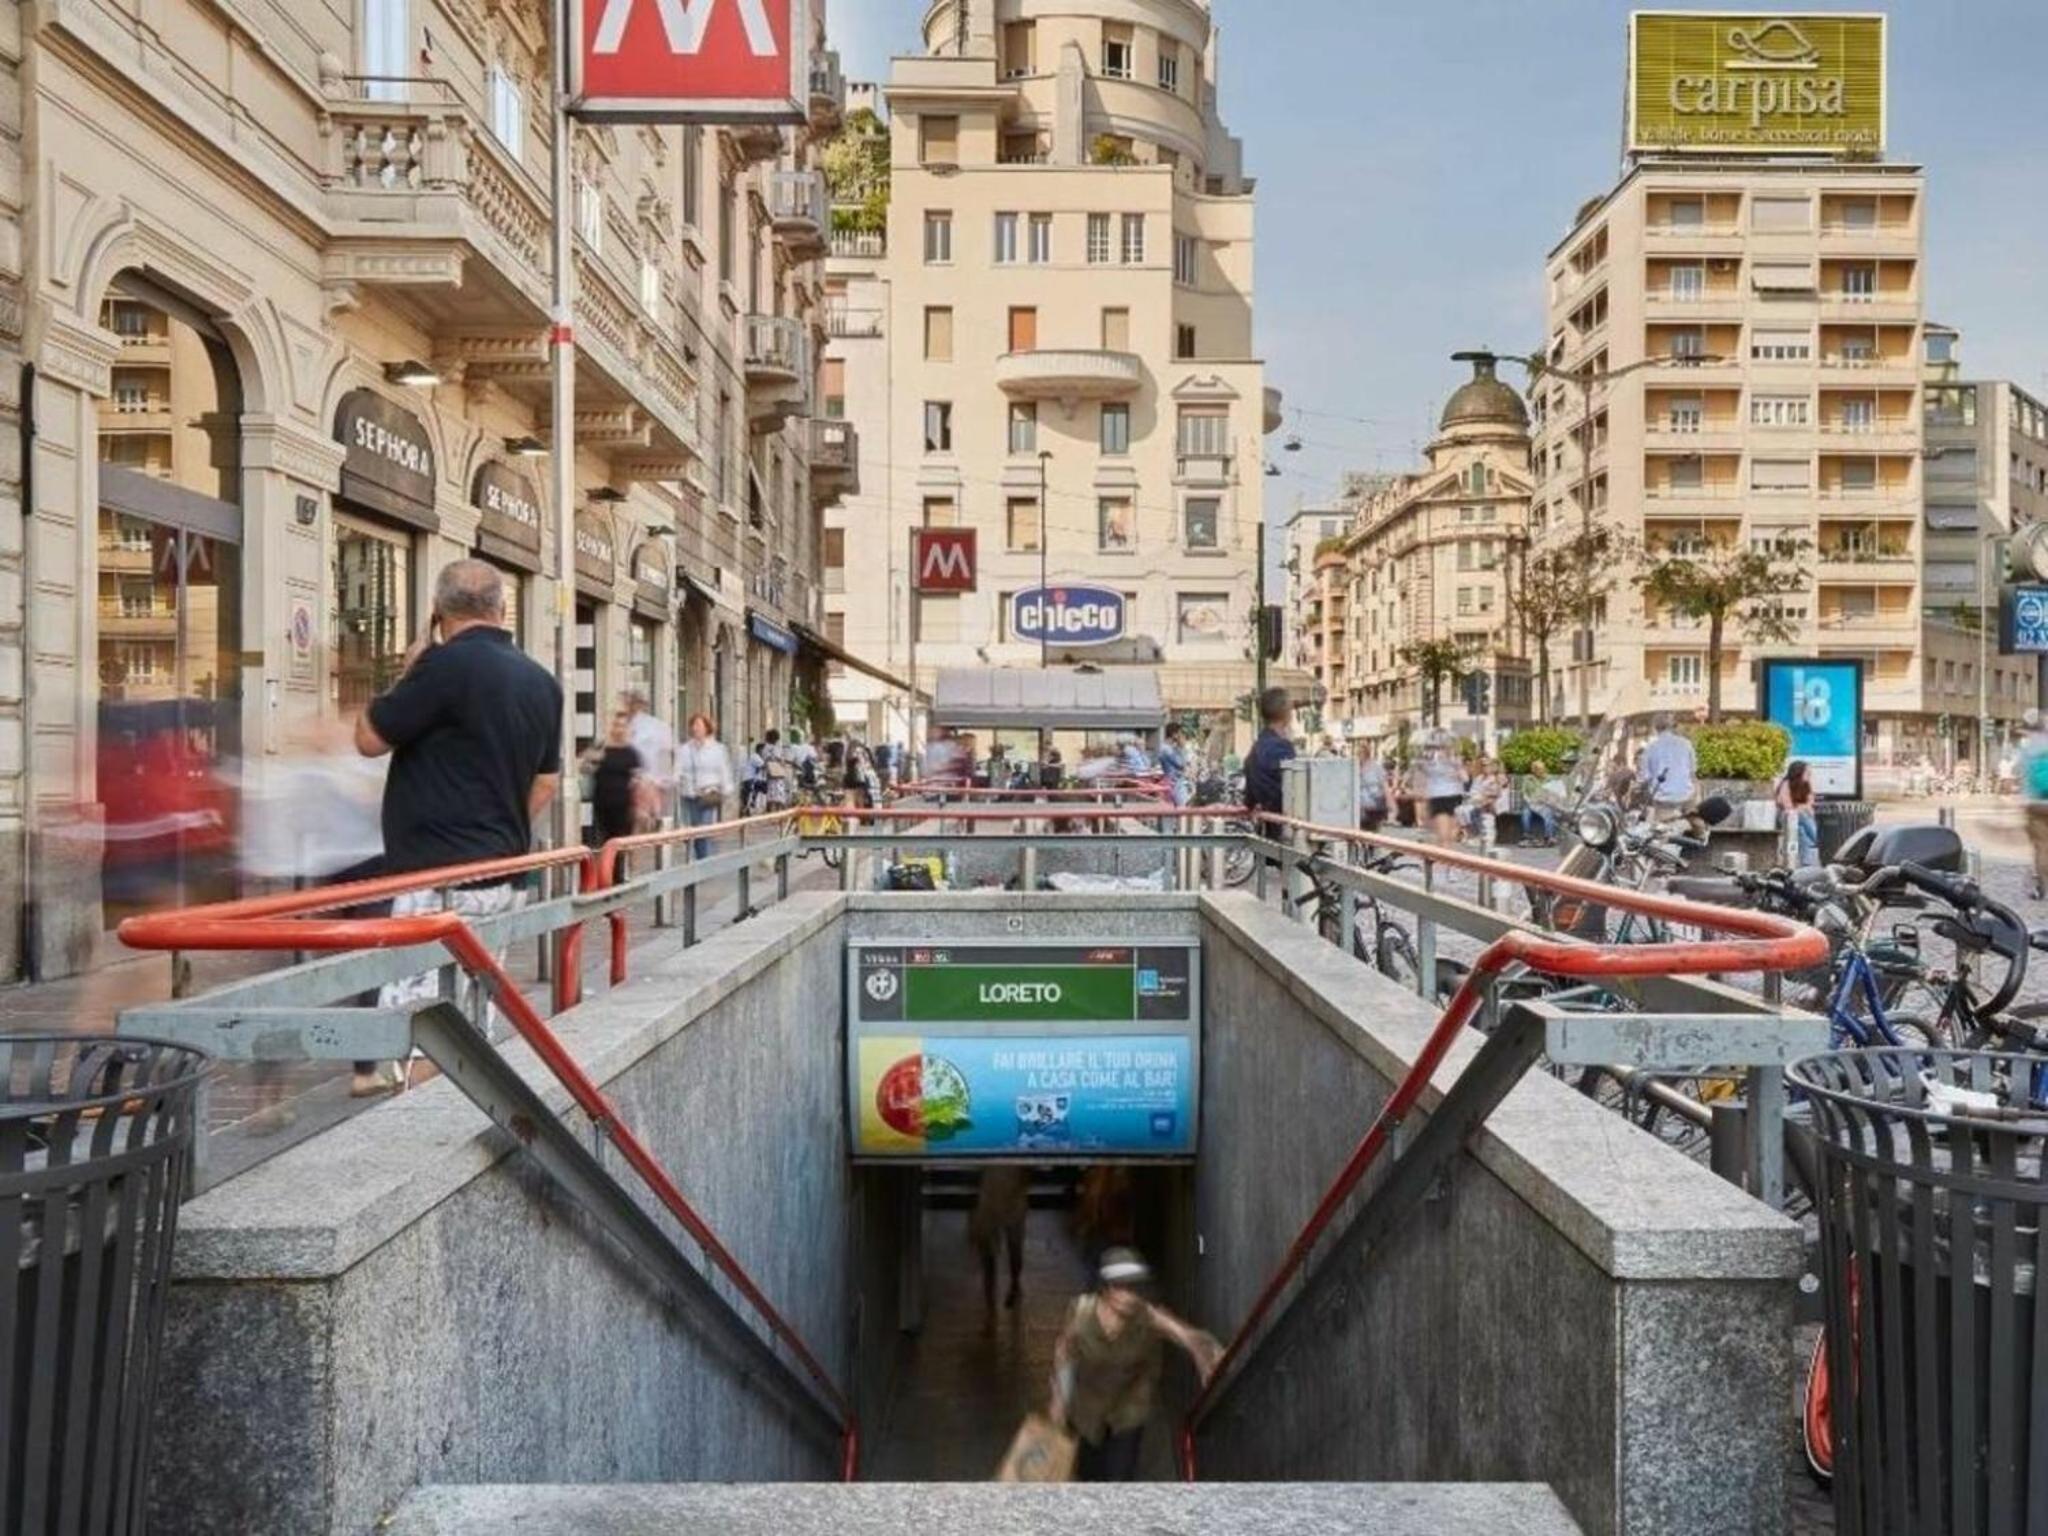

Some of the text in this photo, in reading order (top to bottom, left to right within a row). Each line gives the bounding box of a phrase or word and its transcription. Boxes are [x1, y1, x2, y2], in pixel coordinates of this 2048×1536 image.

[1671, 75, 1845, 128] carpisa
[356, 416, 430, 477] SEPHORA
[487, 484, 538, 529] SEPHORA
[922, 542, 971, 578] M
[1021, 588, 1117, 632] chicco
[980, 982, 1062, 1003] LORETO
[1027, 1071, 1038, 1089] A
[1040, 1071, 1075, 1089] CASA
[1080, 1070, 1120, 1088] COME
